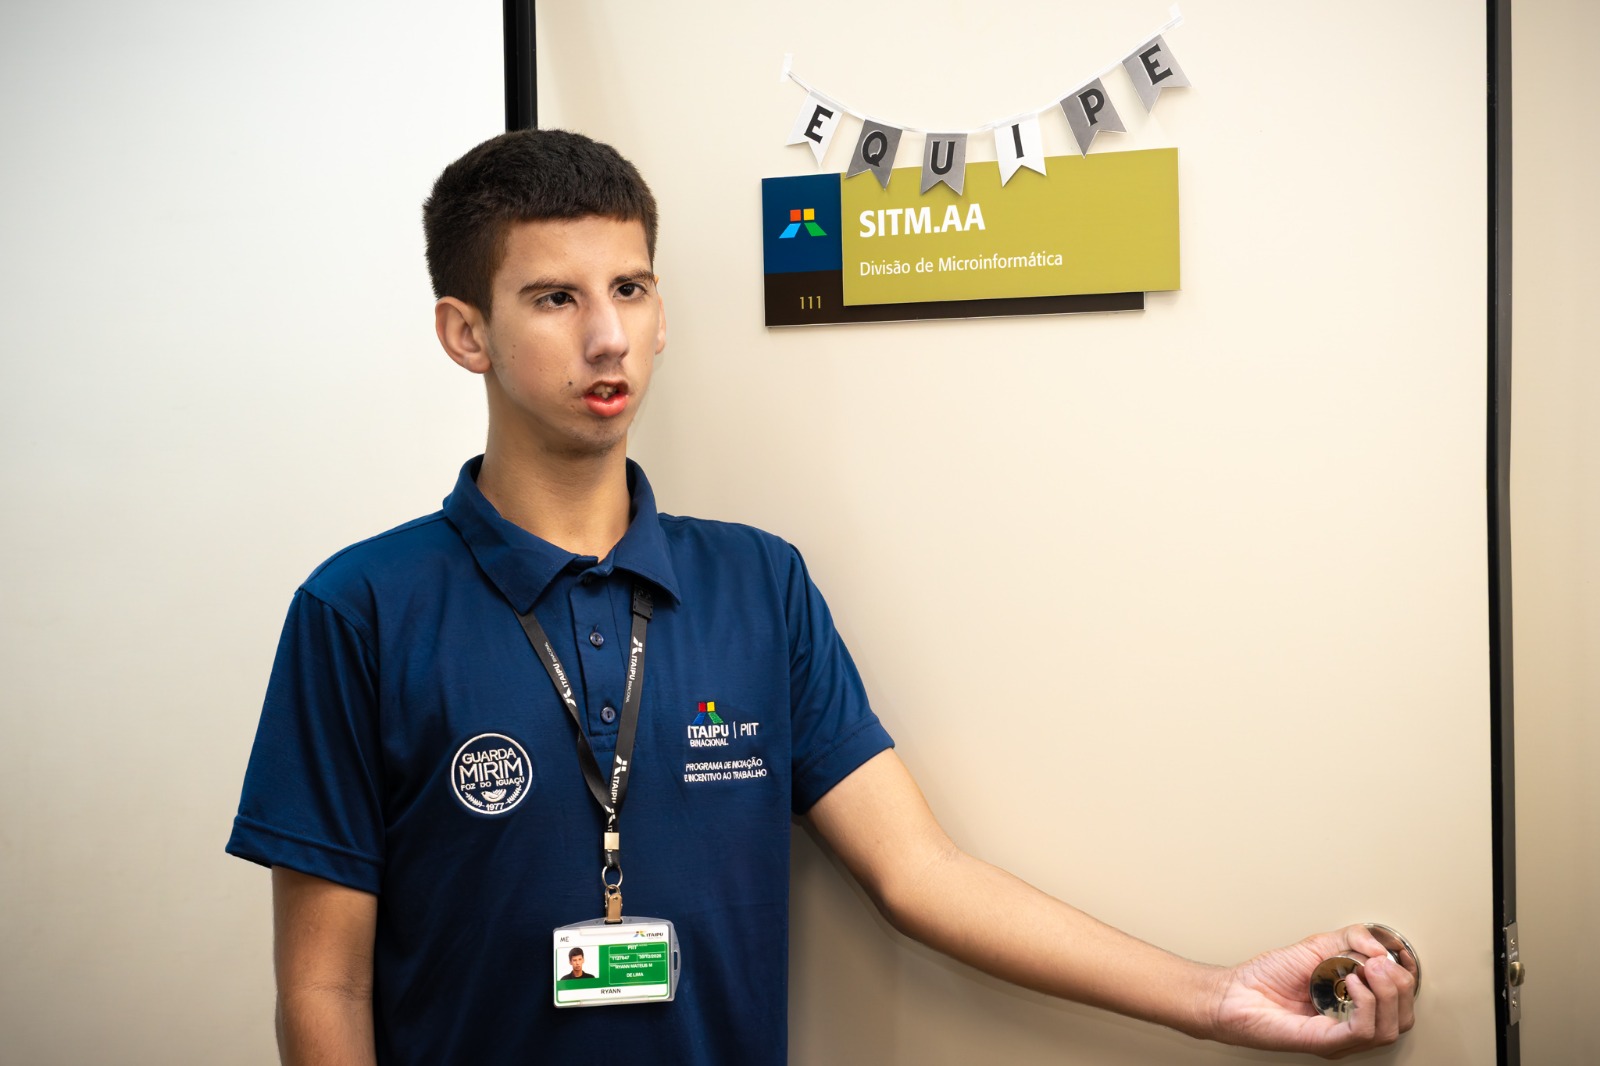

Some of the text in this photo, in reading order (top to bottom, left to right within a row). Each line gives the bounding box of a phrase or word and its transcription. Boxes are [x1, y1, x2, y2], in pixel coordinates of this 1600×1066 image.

[859, 203, 986, 238] SITM.AA
[859, 252, 1063, 277] Divisão de Microinformática
[799, 295, 822, 310] 111
[553, 663, 569, 687] ITAIPU
[629, 656, 638, 680] ITAIPU
[687, 724, 730, 739] ITAIPU
[689, 738, 729, 747] BINACIONAL
[462, 747, 516, 764] GUARDA
[459, 757, 523, 784] MIRIM
[685, 761, 723, 772] PROGRAMA
[724, 761, 732, 769] DE
[722, 771, 732, 780] AO
[733, 768, 767, 780] TRABALHO
[461, 783, 476, 791] FOZ
[495, 776, 525, 787] IGUAÇU
[486, 802, 504, 811] 1977
